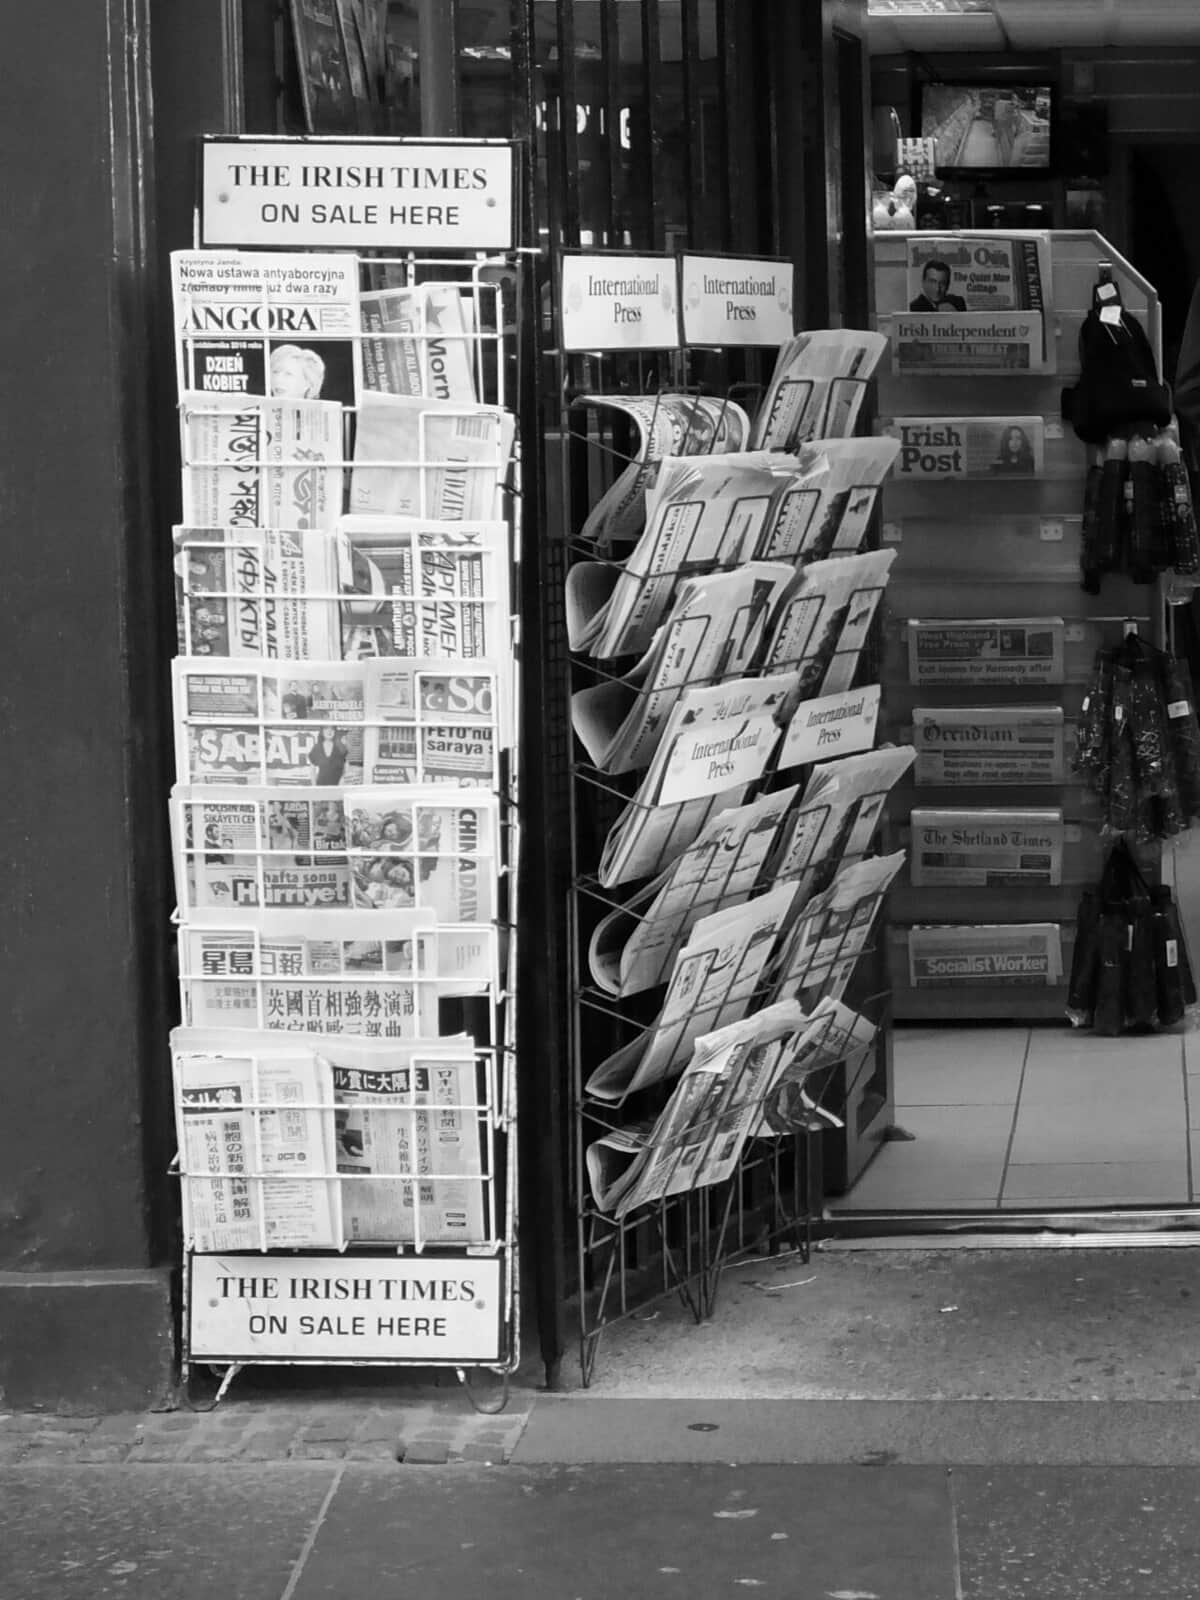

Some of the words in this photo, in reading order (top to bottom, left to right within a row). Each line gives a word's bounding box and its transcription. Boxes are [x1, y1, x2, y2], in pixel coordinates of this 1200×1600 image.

[228, 165, 290, 186] THE
[302, 166, 384, 188] IRISH
[391, 168, 488, 189] TIMES
[262, 204, 299, 223] ON
[311, 204, 377, 224] SALE
[390, 206, 459, 225] HERE
[180, 267, 212, 278] Nowa
[217, 268, 259, 278] ustawa
[264, 268, 344, 281] antyaborcyjna
[286, 282, 309, 293] dwa
[313, 284, 338, 295] razy
[588, 275, 659, 297] International
[703, 275, 775, 296] International
[614, 302, 642, 324] Press
[726, 301, 756, 321] Press
[899, 324, 929, 337] Irish
[933, 324, 1016, 341] Independent
[206, 352, 243, 373] DZIEŃ
[203, 375, 248, 391] KOBIET
[901, 426, 961, 447] Irish
[901, 449, 961, 473] Post
[806, 698, 863, 728] International
[427, 739, 483, 755] saraya
[691, 727, 762, 761] International
[816, 728, 842, 746] Press
[707, 759, 735, 780] Press
[458, 808, 477, 872] CHINA
[922, 829, 947, 846] The
[951, 829, 1008, 847] Shetland
[1012, 831, 1053, 847] Times
[263, 871, 299, 882] hafta
[303, 873, 336, 882] sonu
[459, 873, 477, 922] DAILY
[202, 950, 304, 976] 星島日報
[927, 956, 991, 974] Socialist
[994, 956, 1048, 972] Worker
[216, 1277, 279, 1299] THE
[290, 1278, 372, 1300] IRISH
[379, 1279, 475, 1301] TIMES
[249, 1315, 287, 1334] ON
[300, 1316, 366, 1335] SALE
[377, 1317, 446, 1336] HERE
